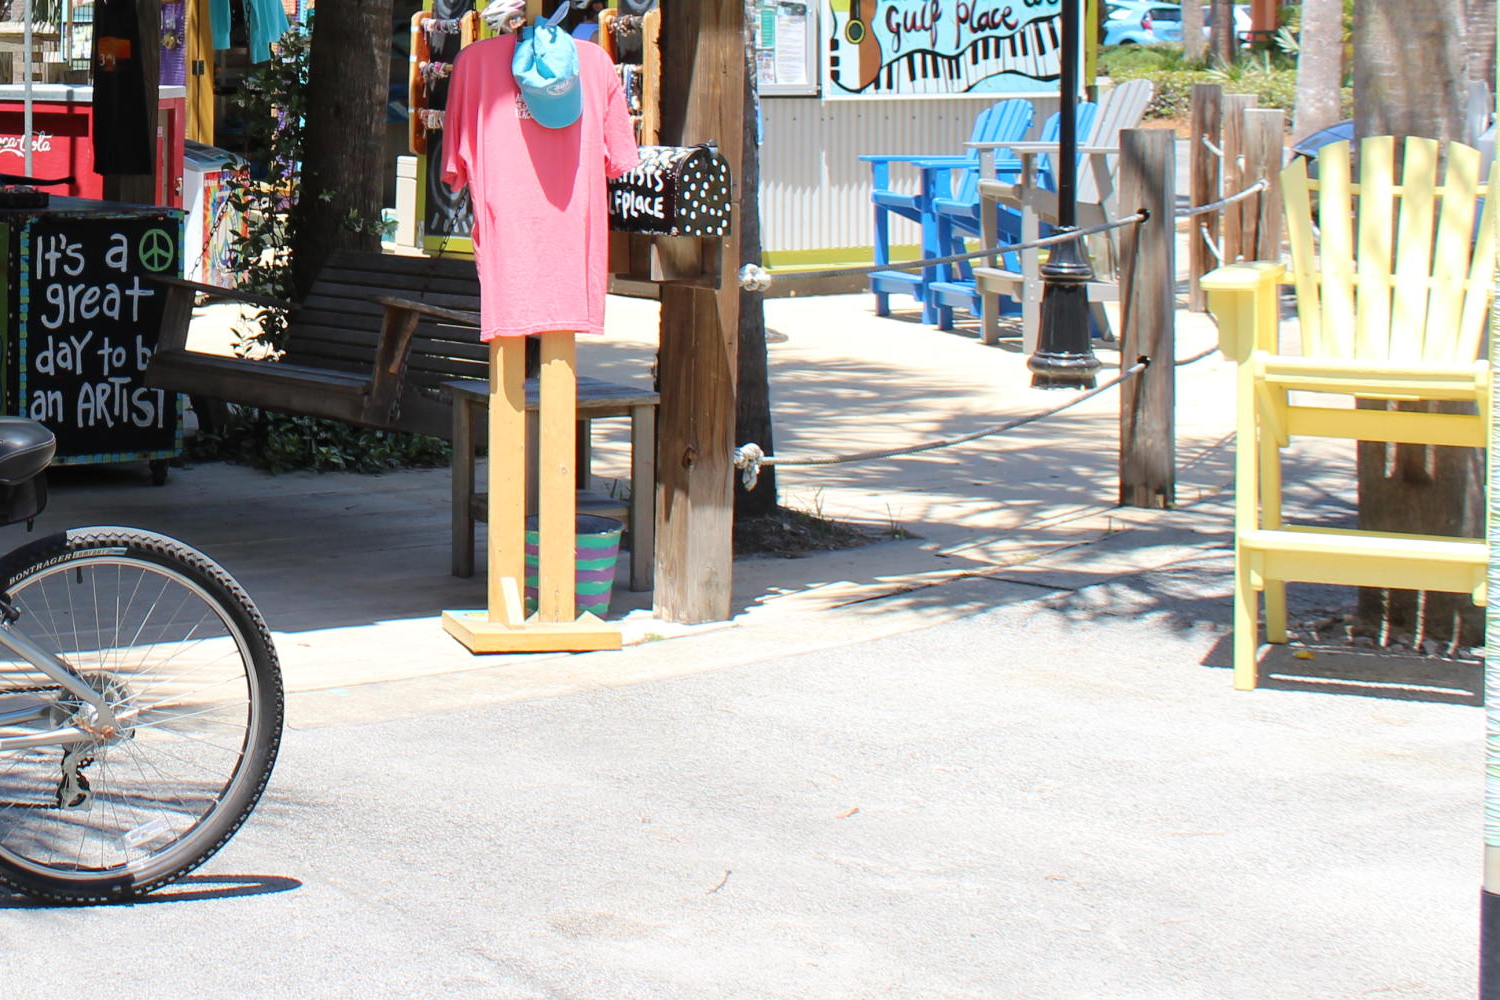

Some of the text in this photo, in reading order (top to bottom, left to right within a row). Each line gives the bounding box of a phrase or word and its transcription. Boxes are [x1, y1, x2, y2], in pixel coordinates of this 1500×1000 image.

[36, 233, 129, 280] It's a
[41, 276, 155, 330] great
[97, 338, 126, 378] to
[30, 388, 64, 424] an
[8, 552, 74, 586] BONTRAGER
